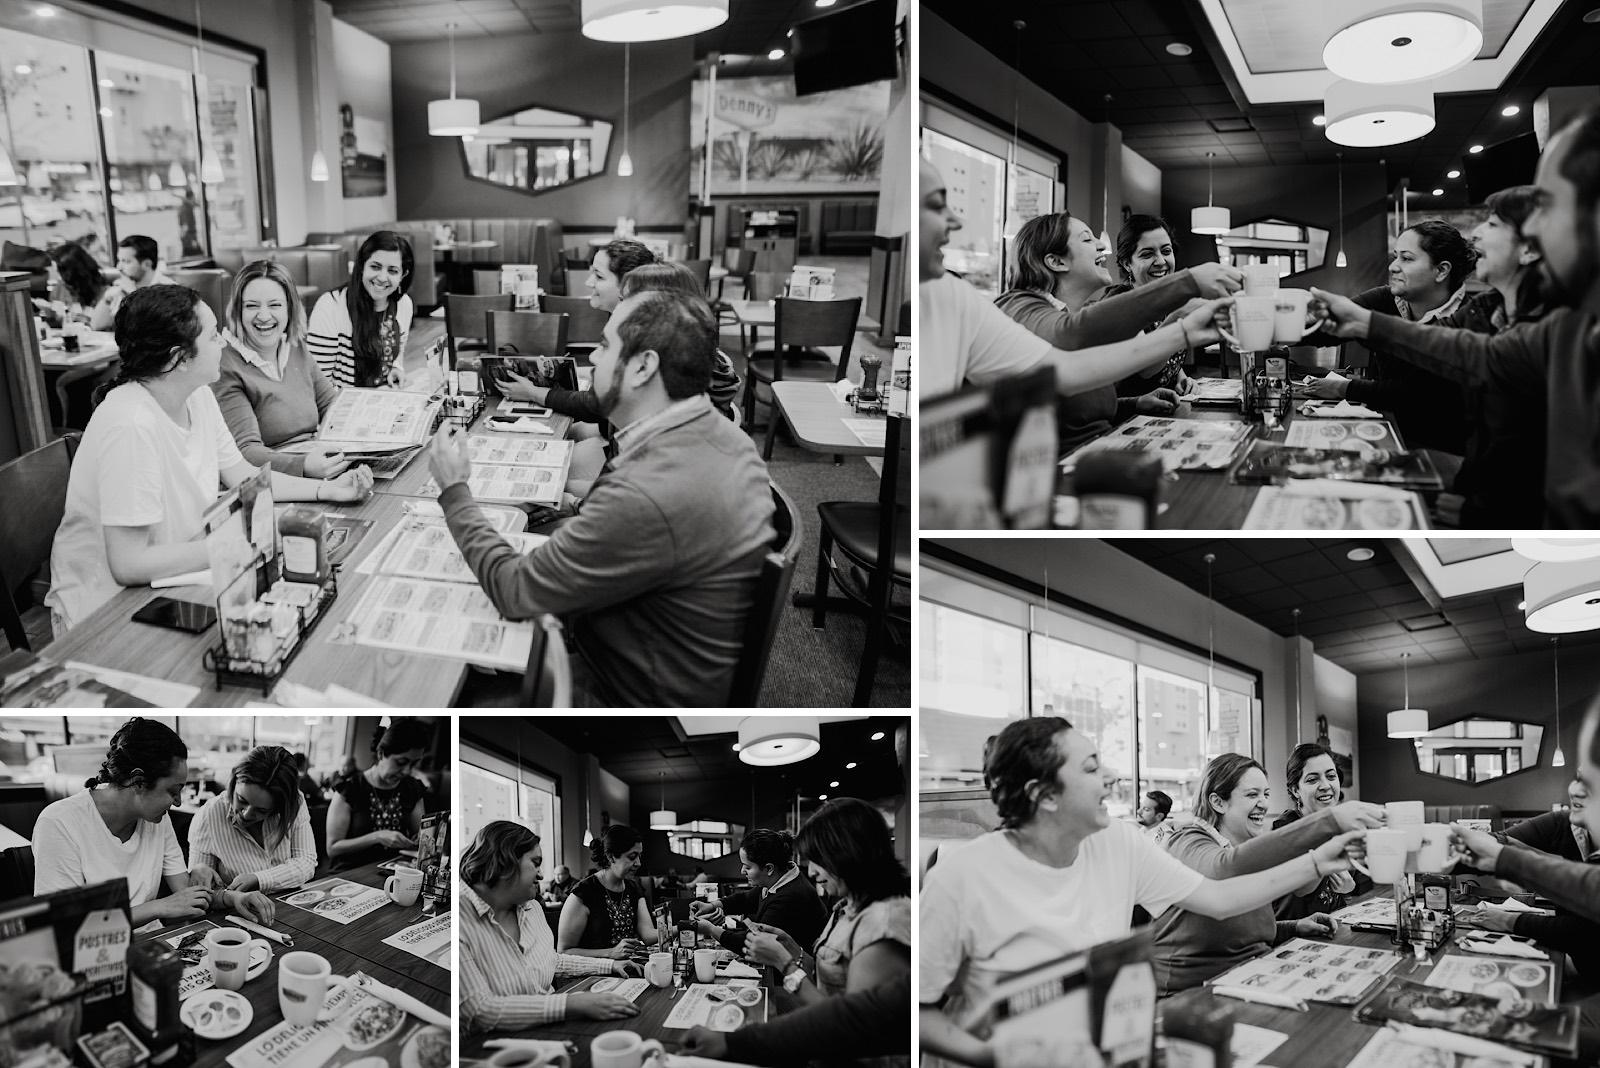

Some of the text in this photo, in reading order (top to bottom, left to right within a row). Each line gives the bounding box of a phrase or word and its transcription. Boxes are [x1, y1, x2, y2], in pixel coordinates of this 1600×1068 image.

[78, 931, 126, 950] POSTRES
[256, 1042, 275, 1057] LO
[274, 1023, 304, 1046] DELIC
[267, 1041, 298, 1065] TIENE
[299, 1030, 315, 1043] UN
